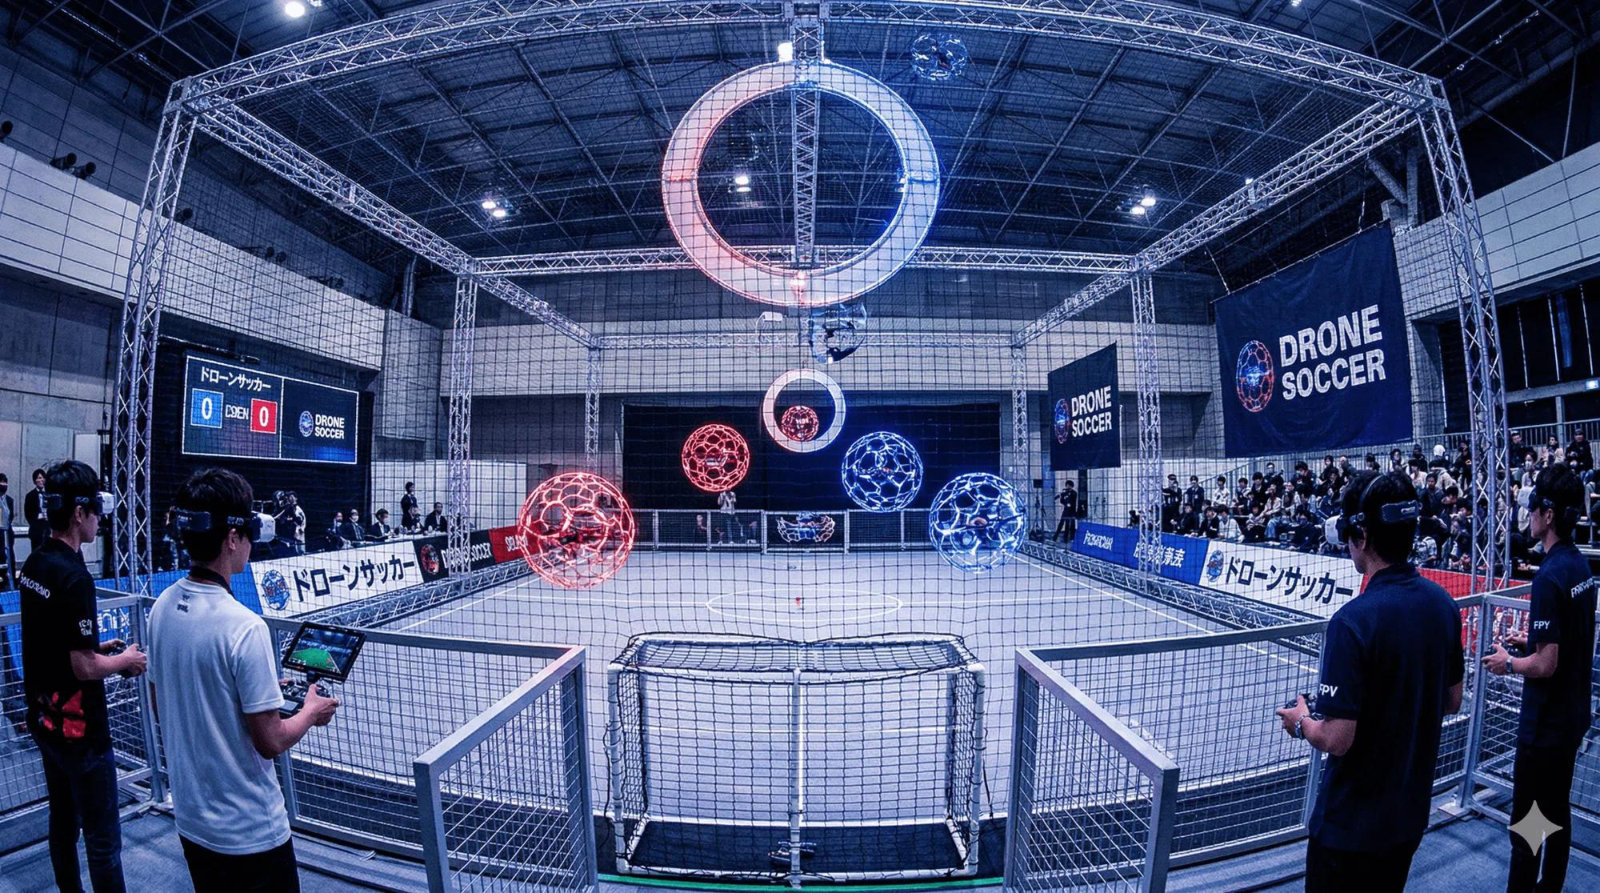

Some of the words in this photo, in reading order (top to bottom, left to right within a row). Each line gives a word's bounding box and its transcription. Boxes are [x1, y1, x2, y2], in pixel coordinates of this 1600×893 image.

[1279, 304, 1383, 367] DRONE
[201, 366, 271, 392] ドローンサッカー
[1282, 349, 1386, 401] SOCCER
[201, 397, 213, 420] 0
[1071, 385, 1112, 417] DRONE
[259, 406, 269, 427] 0
[315, 414, 345, 429] DRONE
[1072, 411, 1112, 437] SOCCER
[314, 427, 345, 440] SOCCER
[293, 554, 415, 602] ドローンサッカー
[1225, 556, 1354, 604] ドローンサッカー
